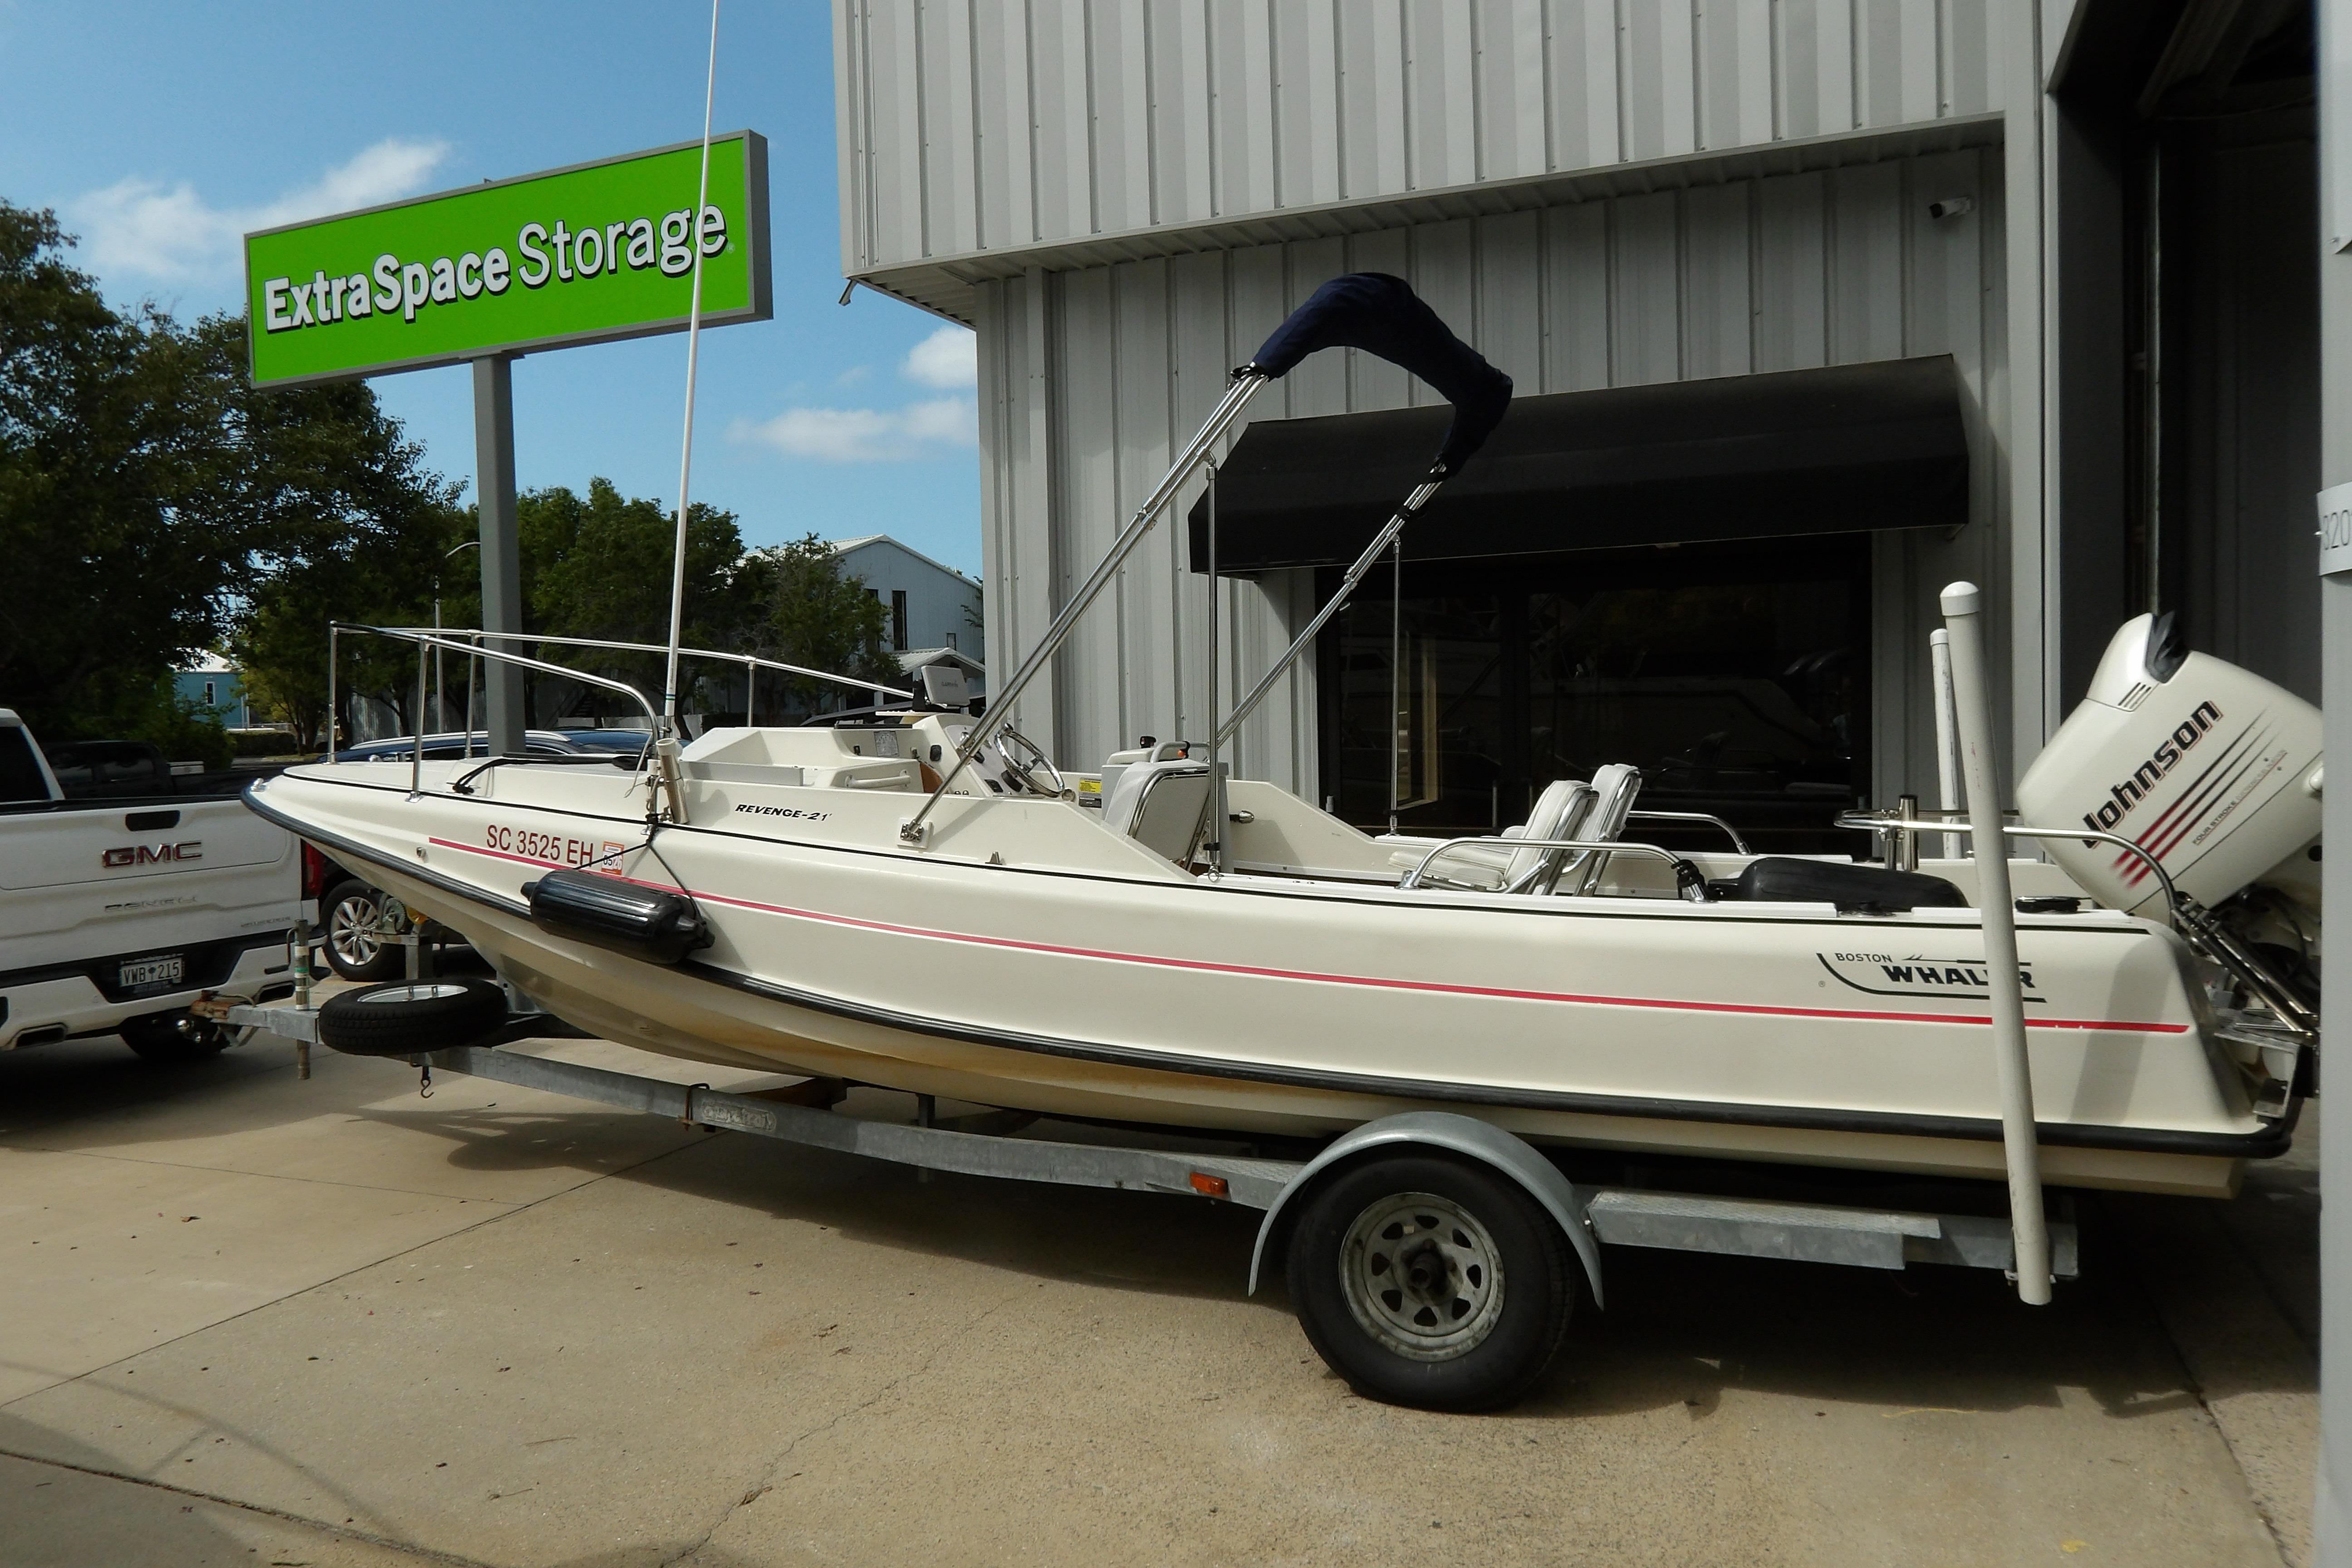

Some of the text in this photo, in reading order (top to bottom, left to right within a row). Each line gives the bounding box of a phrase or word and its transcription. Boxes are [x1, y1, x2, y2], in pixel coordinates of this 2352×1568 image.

[518, 204, 727, 288] Storage
[2082, 700, 2223, 849] Johnson
[102, 840, 203, 868] GMC
[486, 825, 594, 867] SC 3525 EH
[1834, 952, 1893, 963] BOSTON
[123, 961, 179, 985] VWB 215
[1880, 965, 2036, 988] WHALR
